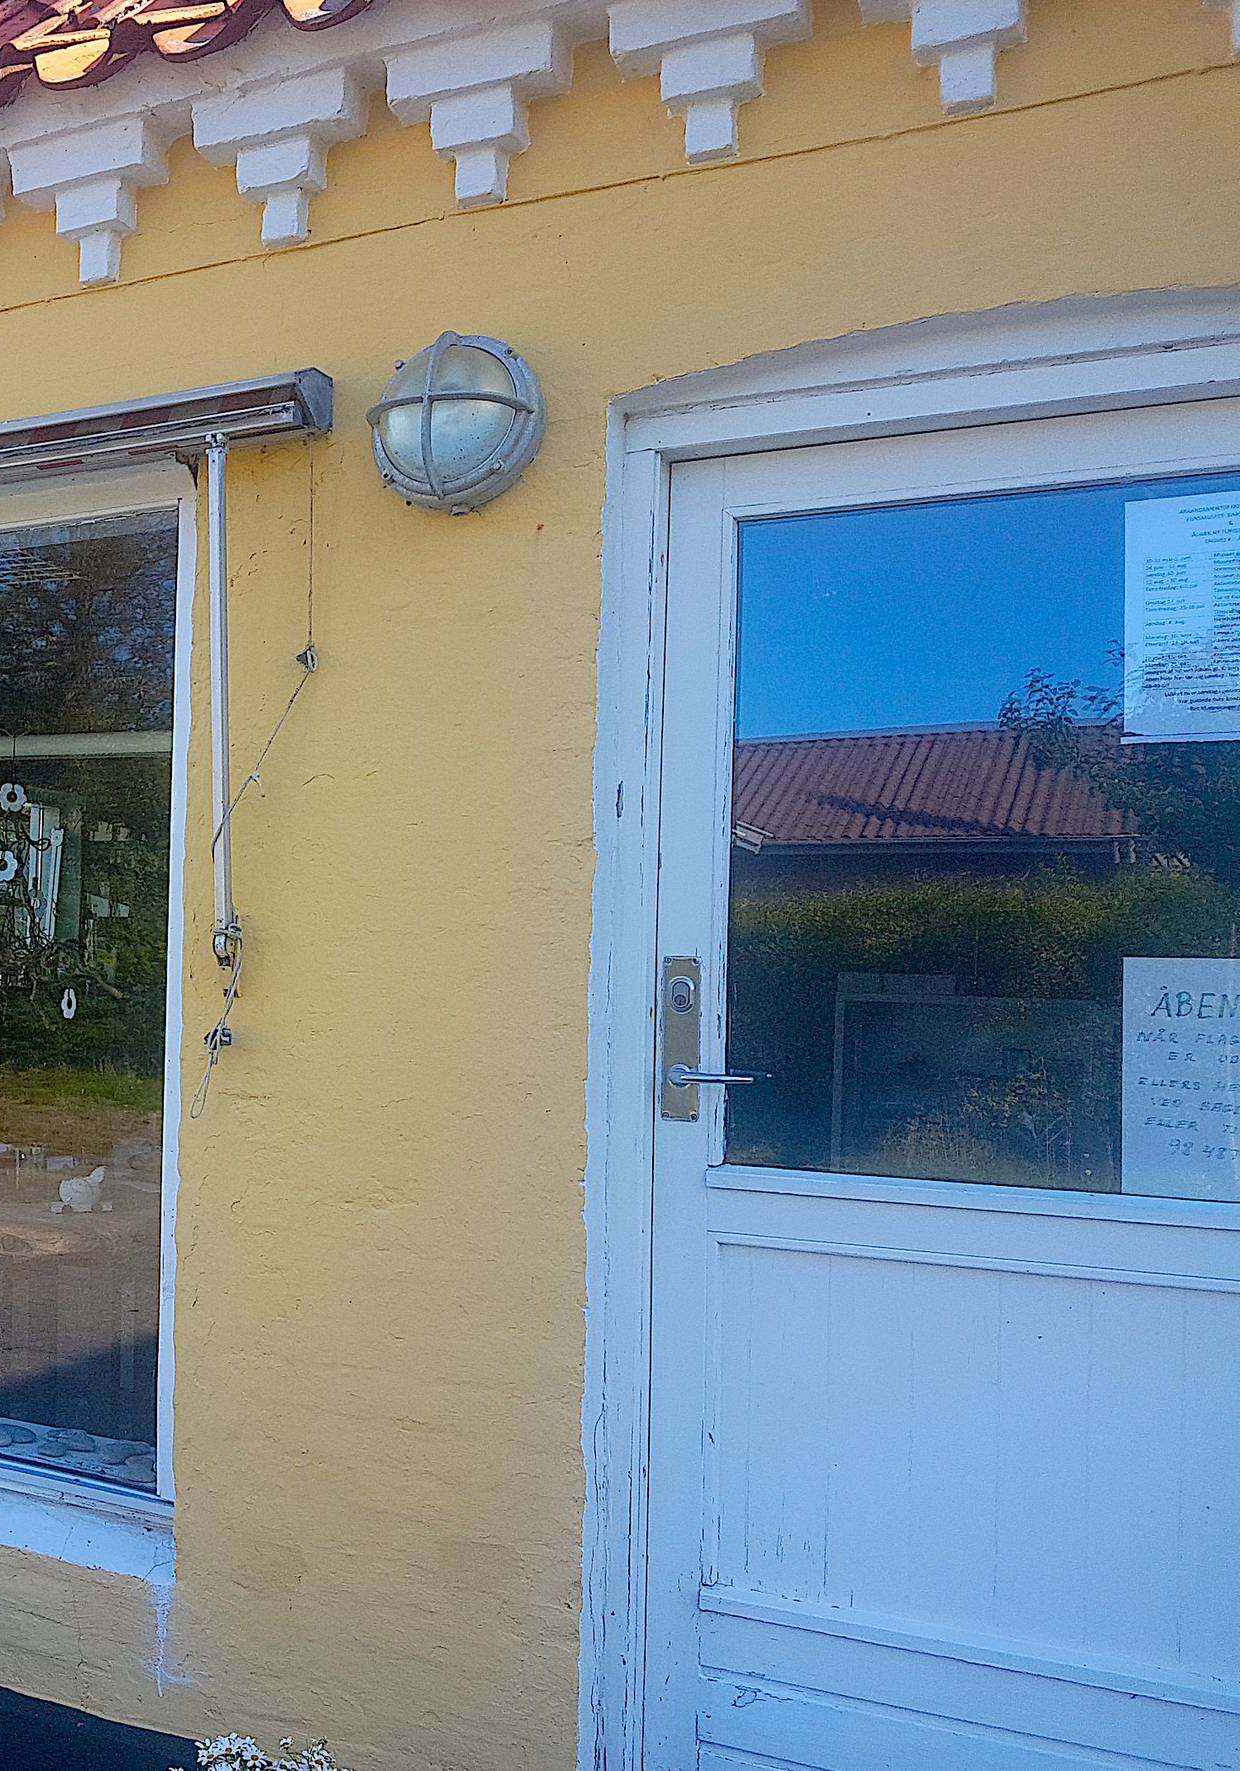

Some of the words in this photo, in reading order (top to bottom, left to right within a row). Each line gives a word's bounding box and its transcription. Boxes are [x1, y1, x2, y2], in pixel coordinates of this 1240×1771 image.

[1135, 1028, 1179, 1044] NÅR
[1167, 1051, 1197, 1063] ER
[1137, 1076, 1201, 1091] ELLERS
[1143, 1115, 1200, 1133] ELLER
